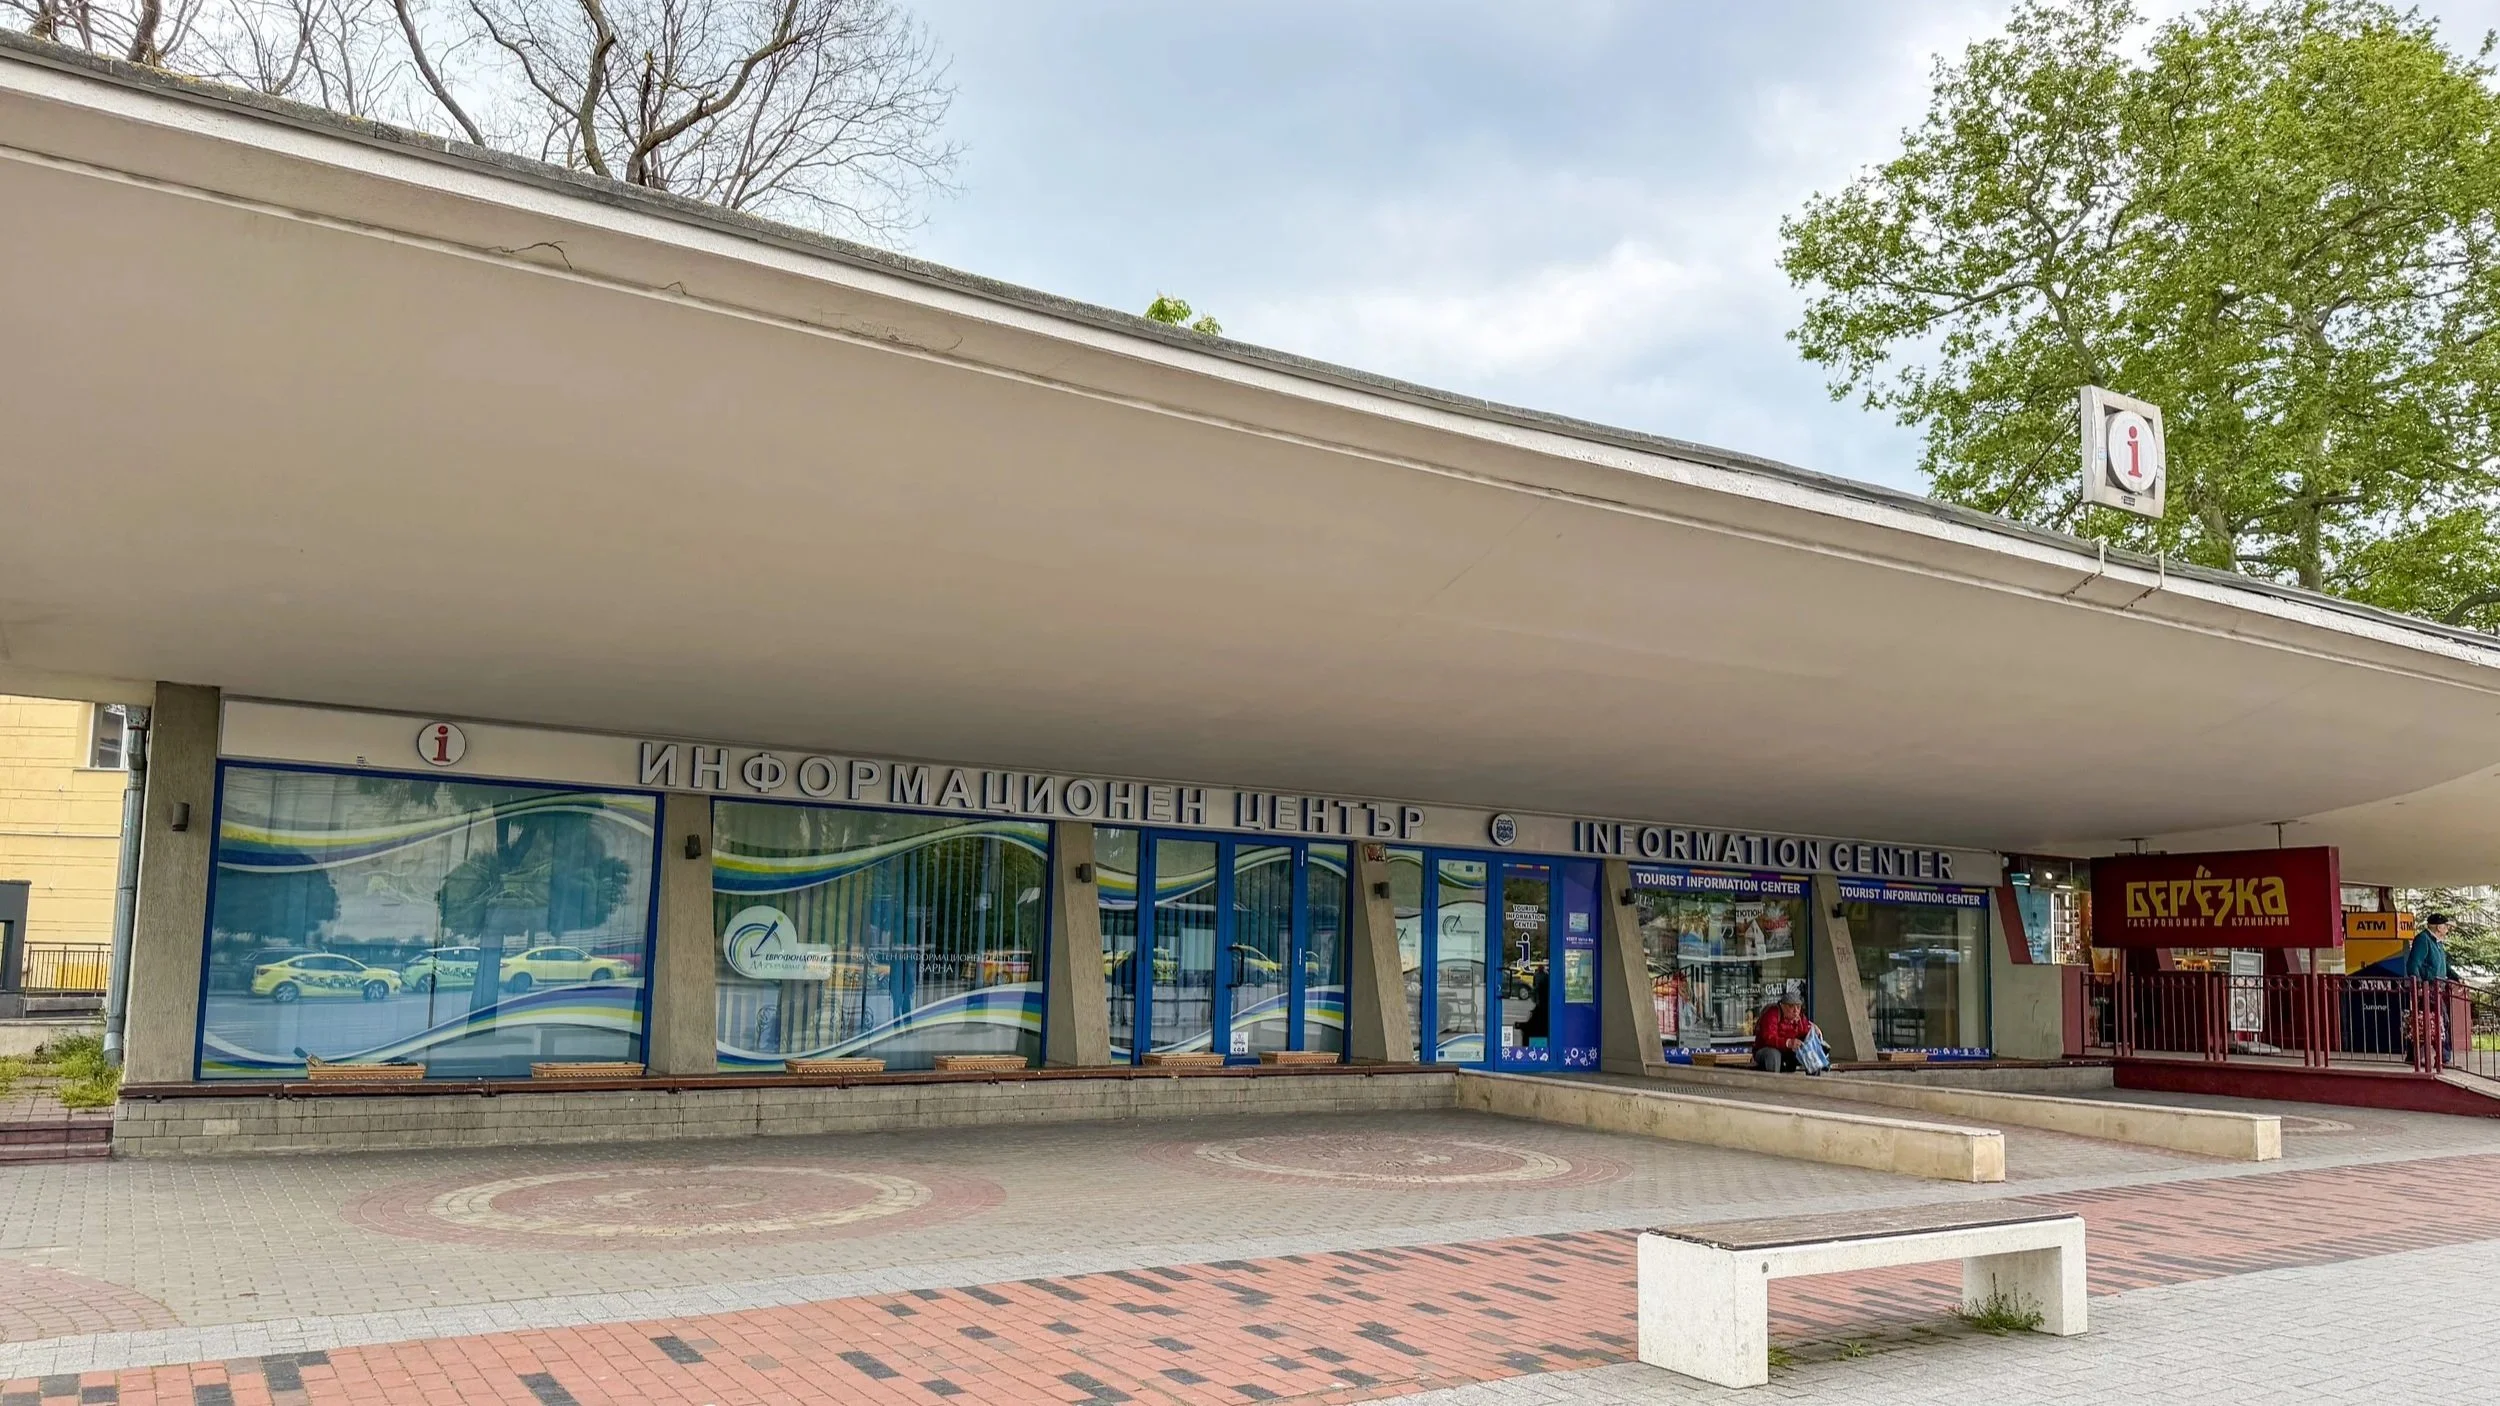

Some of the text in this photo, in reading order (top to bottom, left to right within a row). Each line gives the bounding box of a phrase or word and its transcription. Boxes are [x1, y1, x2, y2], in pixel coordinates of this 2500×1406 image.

[639, 740, 1426, 840] ИНФОРМАЦИОНЕН ЦЕНТЪР
[1573, 820, 1954, 880] INFORMATION CENTER
[1636, 872, 1801, 895] TOURIST INFORMATION CENTER
[1840, 886, 1980, 906] TOURIST INFORMATION CENTER
[2127, 916, 2290, 928] ГАСТРОНОМИЯ КУЛИНАРИЯ
[2356, 920, 2386, 931] ATM
